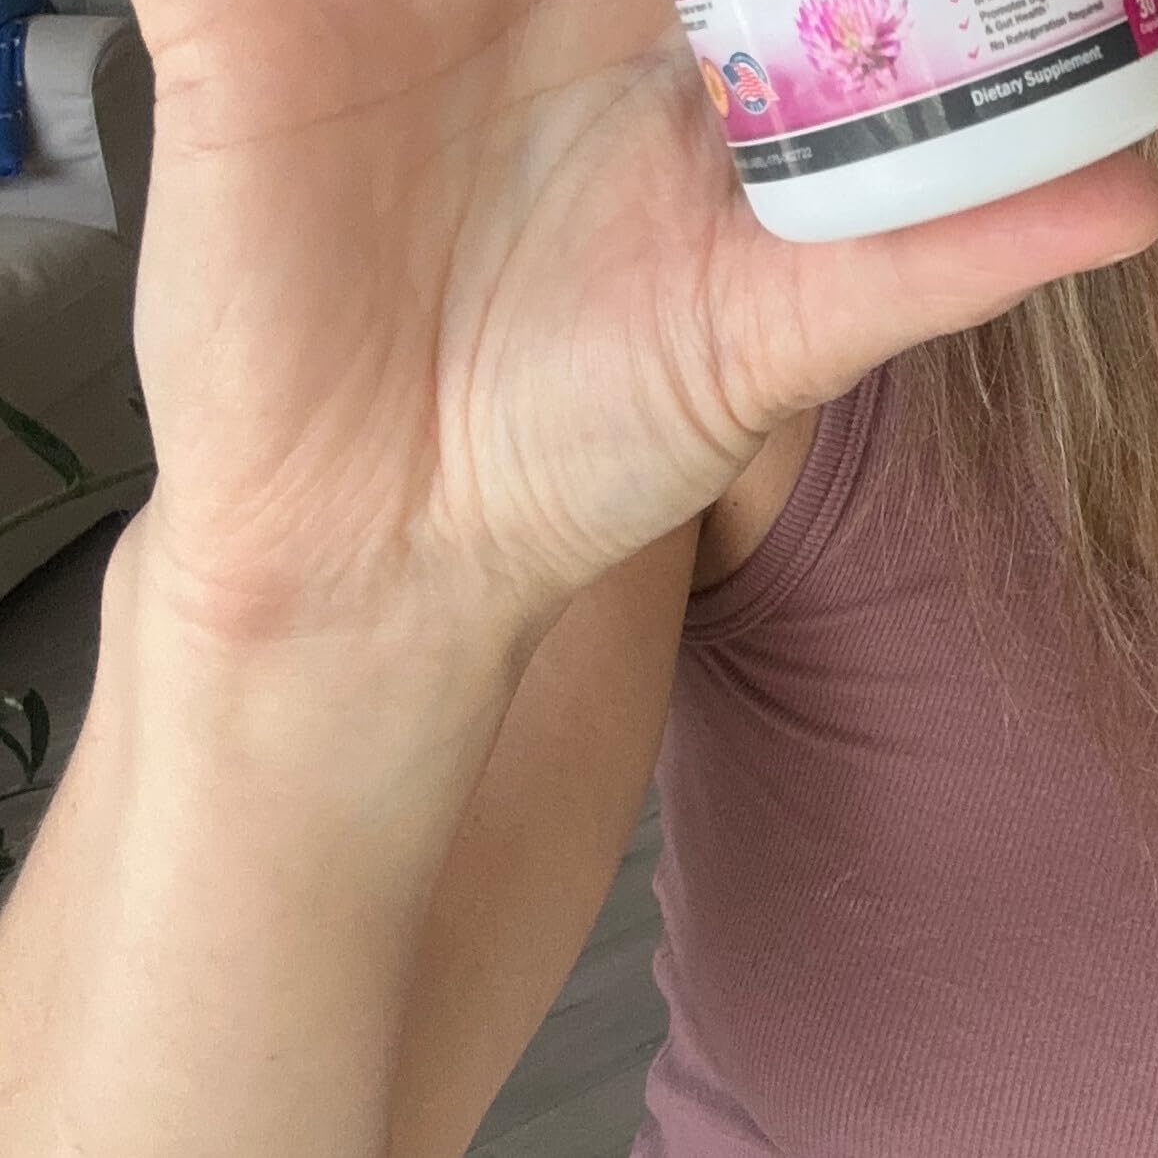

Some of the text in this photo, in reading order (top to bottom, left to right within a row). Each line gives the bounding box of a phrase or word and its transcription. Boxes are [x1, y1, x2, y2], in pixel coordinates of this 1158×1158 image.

[990, 40, 1005, 53] No
[1005, 16, 1068, 45] Refrigeration
[995, 16, 1014, 32] Gut
[970, 44, 1104, 107] Dietary Supplement
